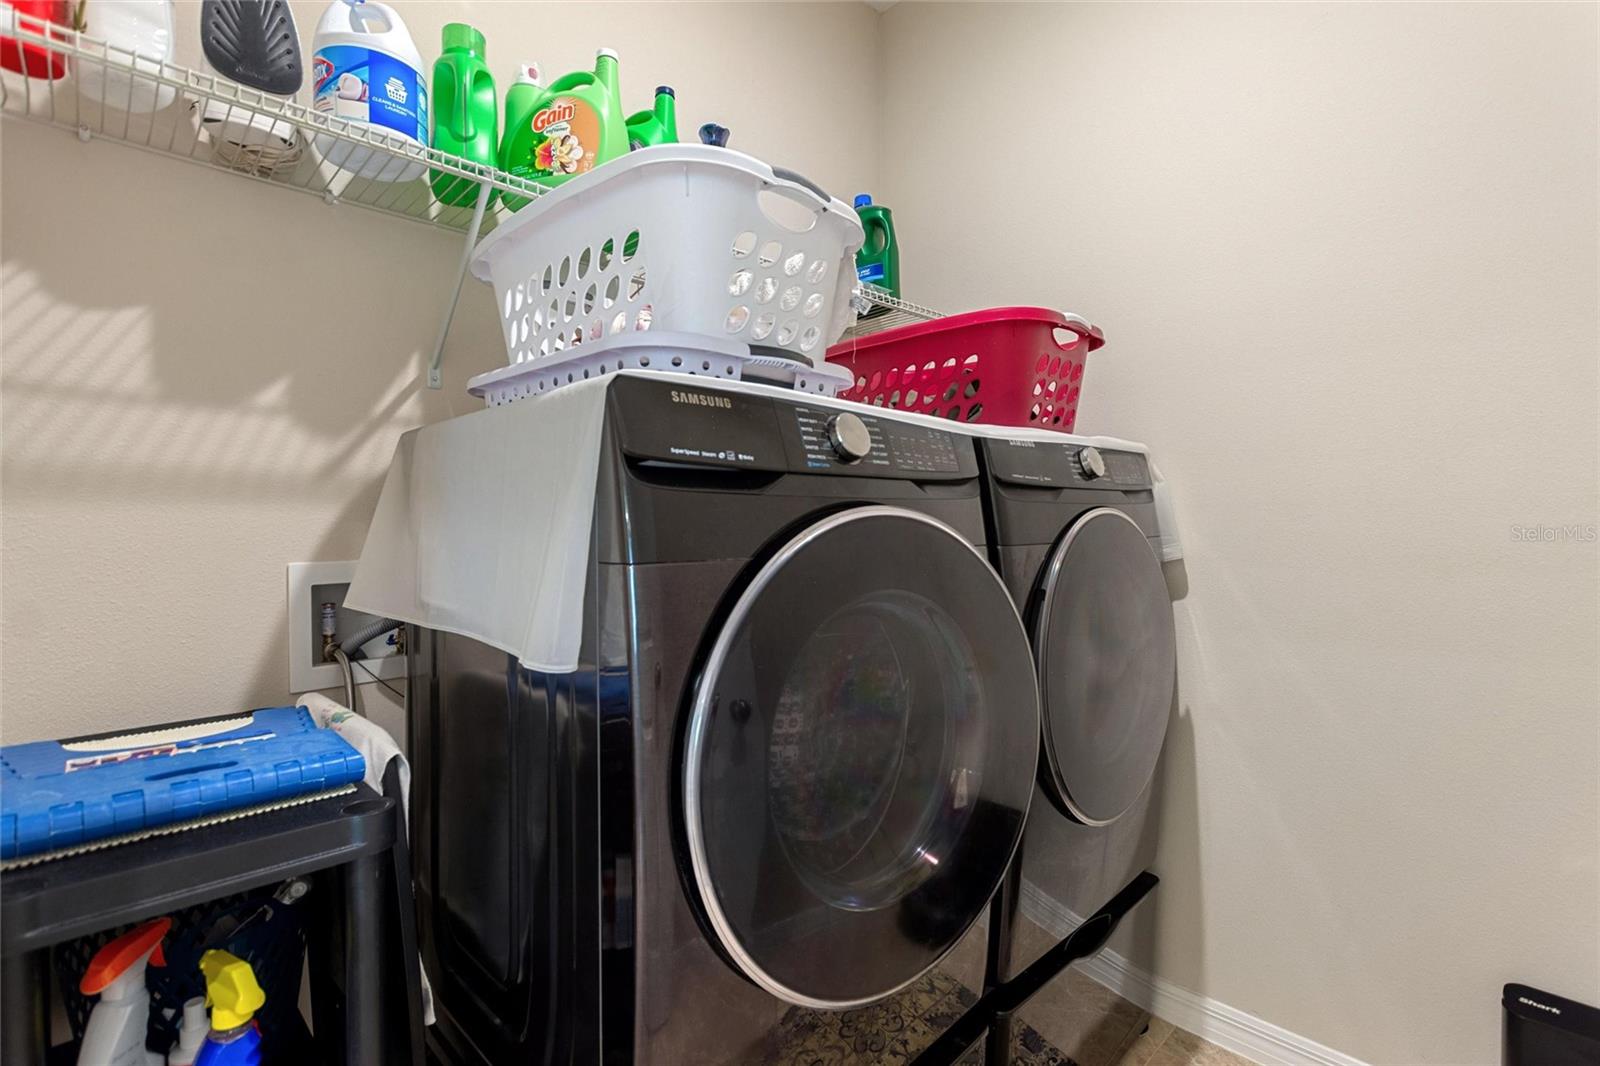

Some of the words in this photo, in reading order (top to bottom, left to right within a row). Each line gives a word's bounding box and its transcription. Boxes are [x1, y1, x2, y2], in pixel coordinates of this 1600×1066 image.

[532, 104, 575, 132] Gain
[671, 390, 732, 409] SAMSUNG
[1519, 996, 1561, 1015] Shark
